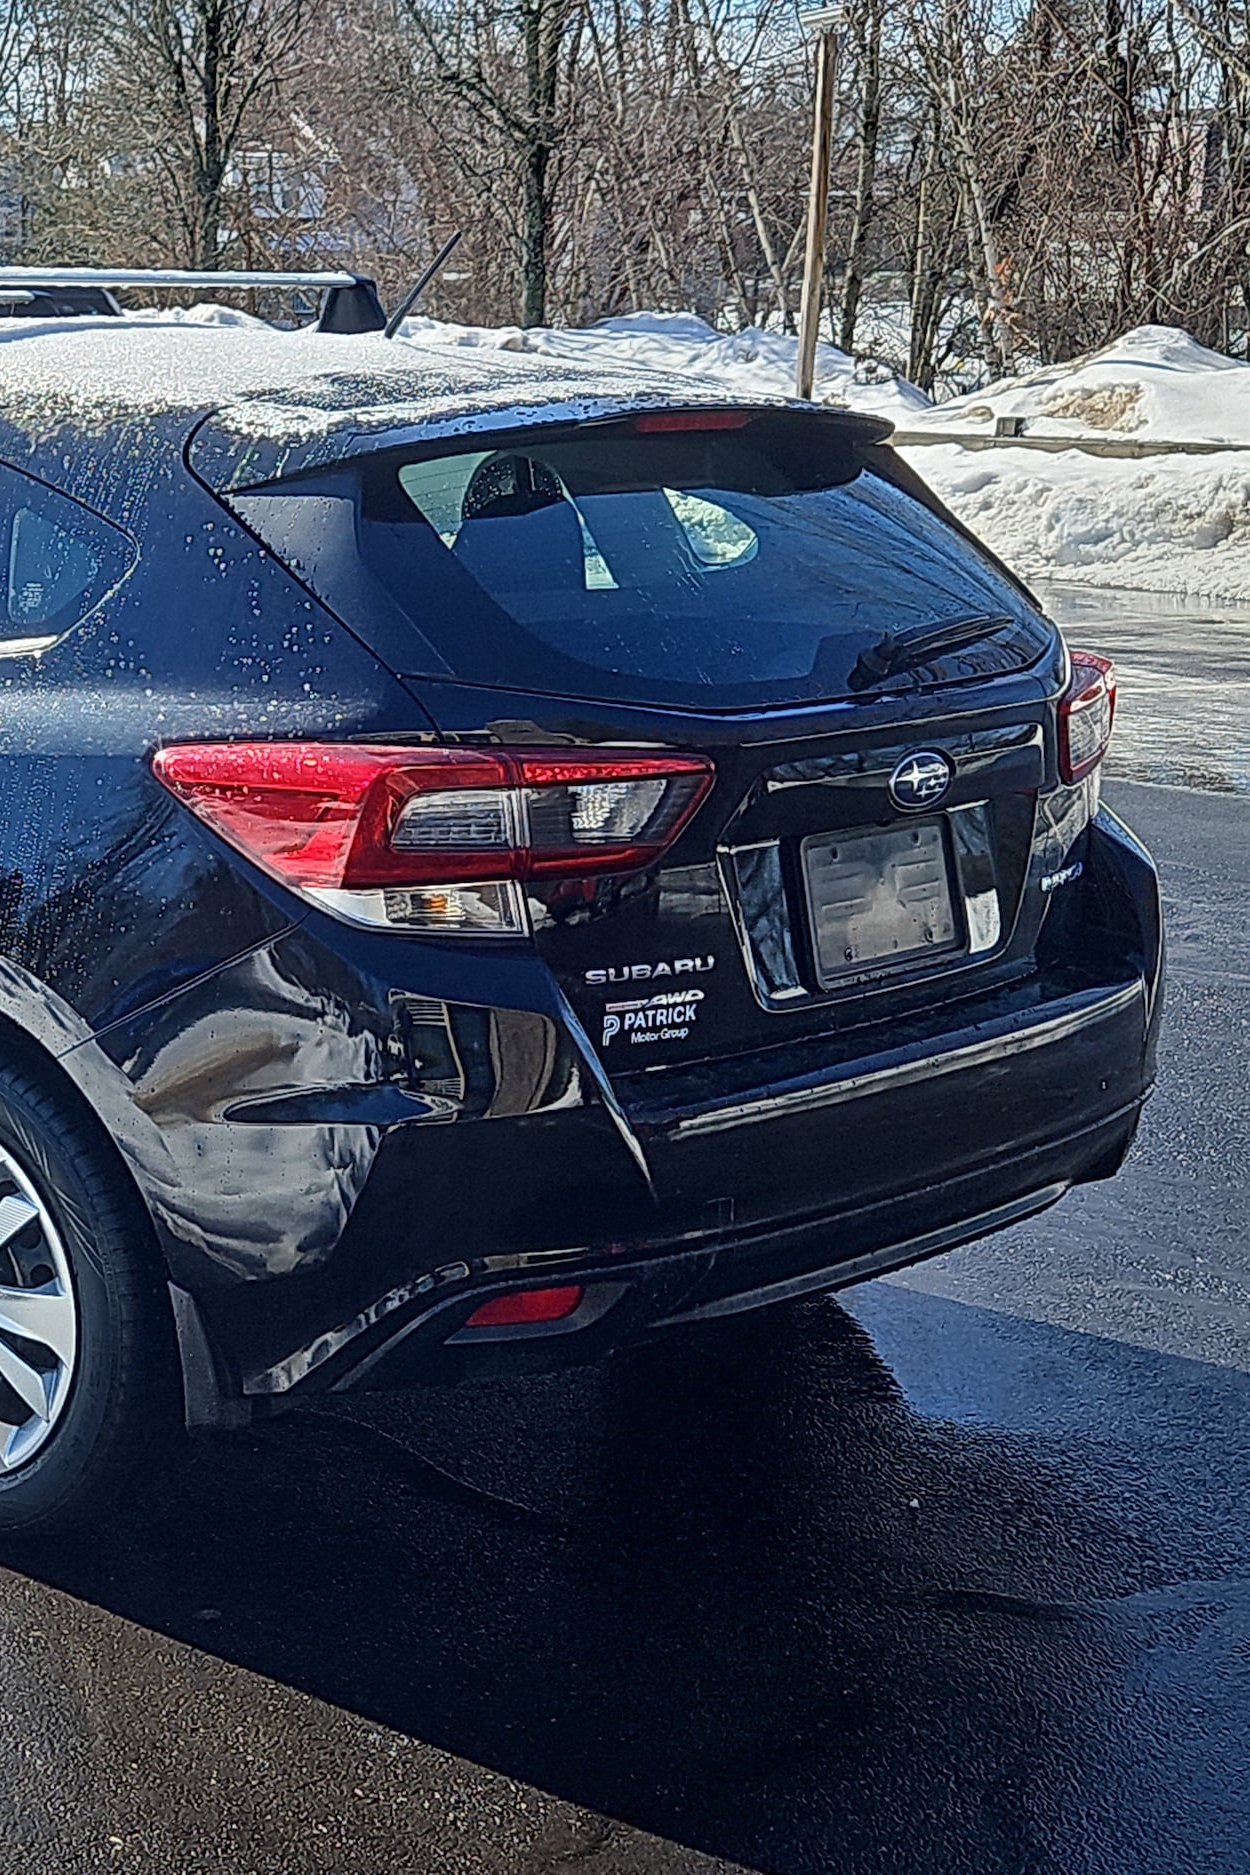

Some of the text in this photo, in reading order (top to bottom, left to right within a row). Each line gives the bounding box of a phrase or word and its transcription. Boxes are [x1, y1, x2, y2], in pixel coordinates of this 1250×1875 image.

[585, 955, 715, 985] SUBARU
[646, 989, 705, 1007] AWD
[623, 1003, 697, 1031] PATRICK
